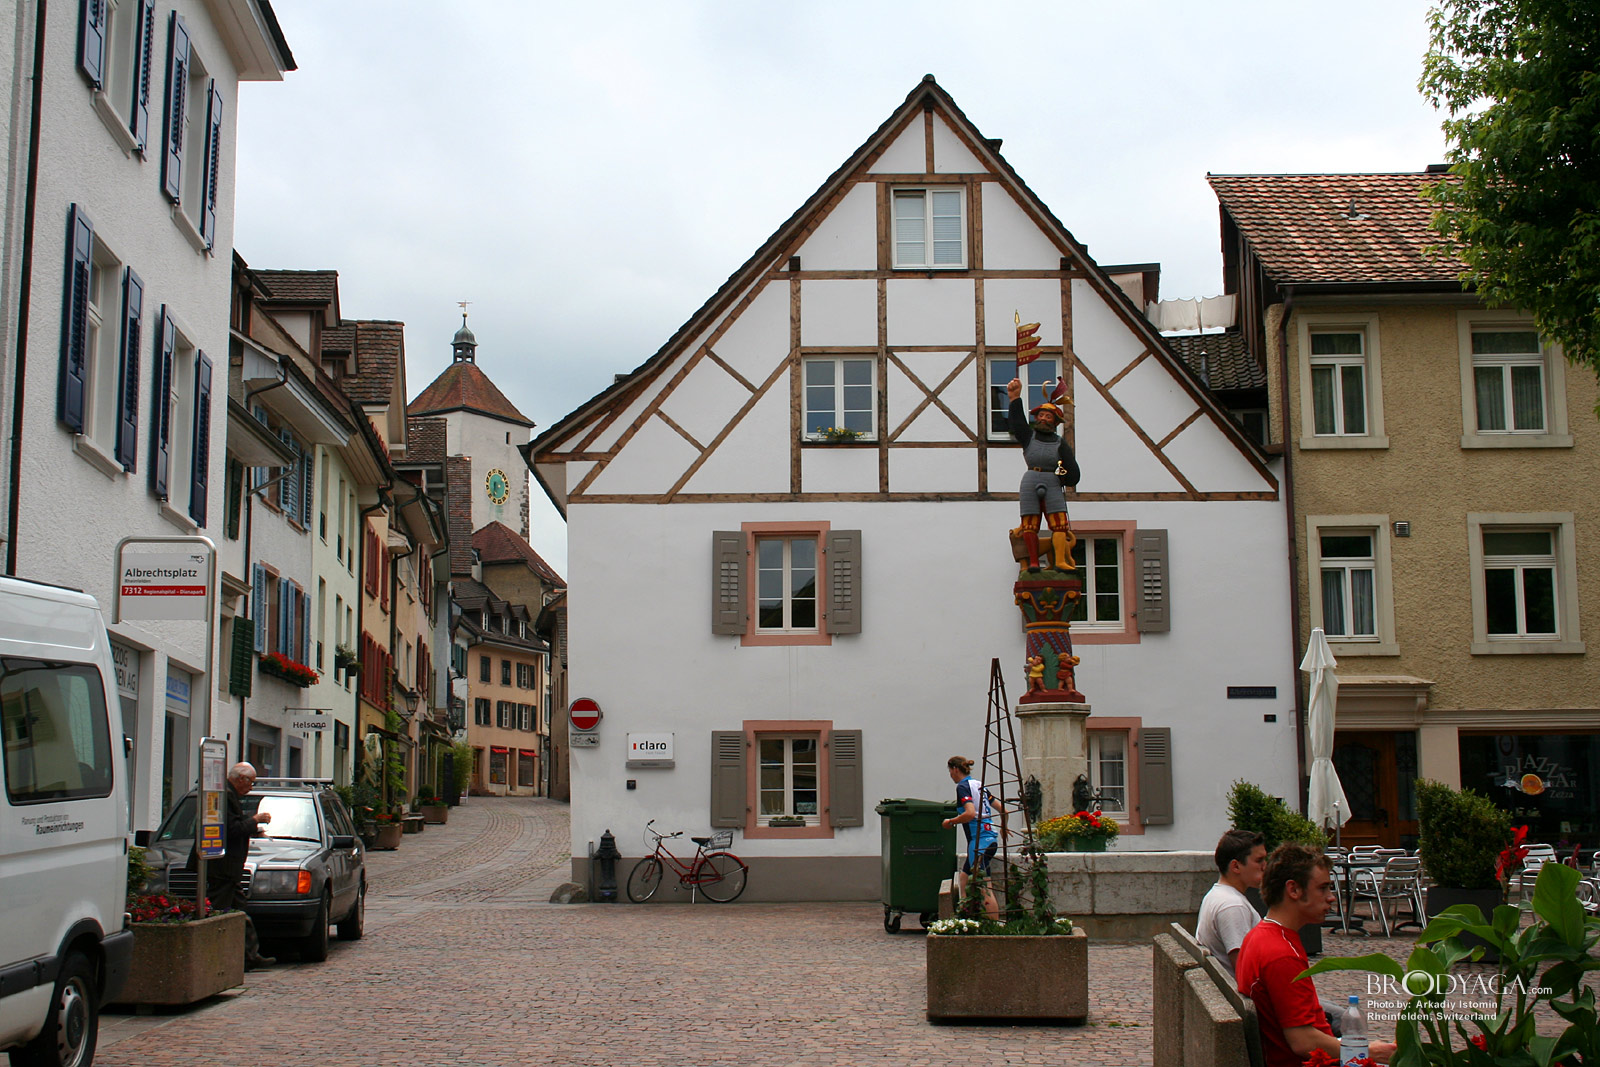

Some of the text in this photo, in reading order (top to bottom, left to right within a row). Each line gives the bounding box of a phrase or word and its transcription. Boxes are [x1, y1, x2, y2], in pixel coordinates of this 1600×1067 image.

[125, 568, 198, 579] Albrechtsplatz
[127, 672, 136, 691] AG
[639, 740, 667, 750] claro
[1504, 754, 1569, 788] PIAZZA
